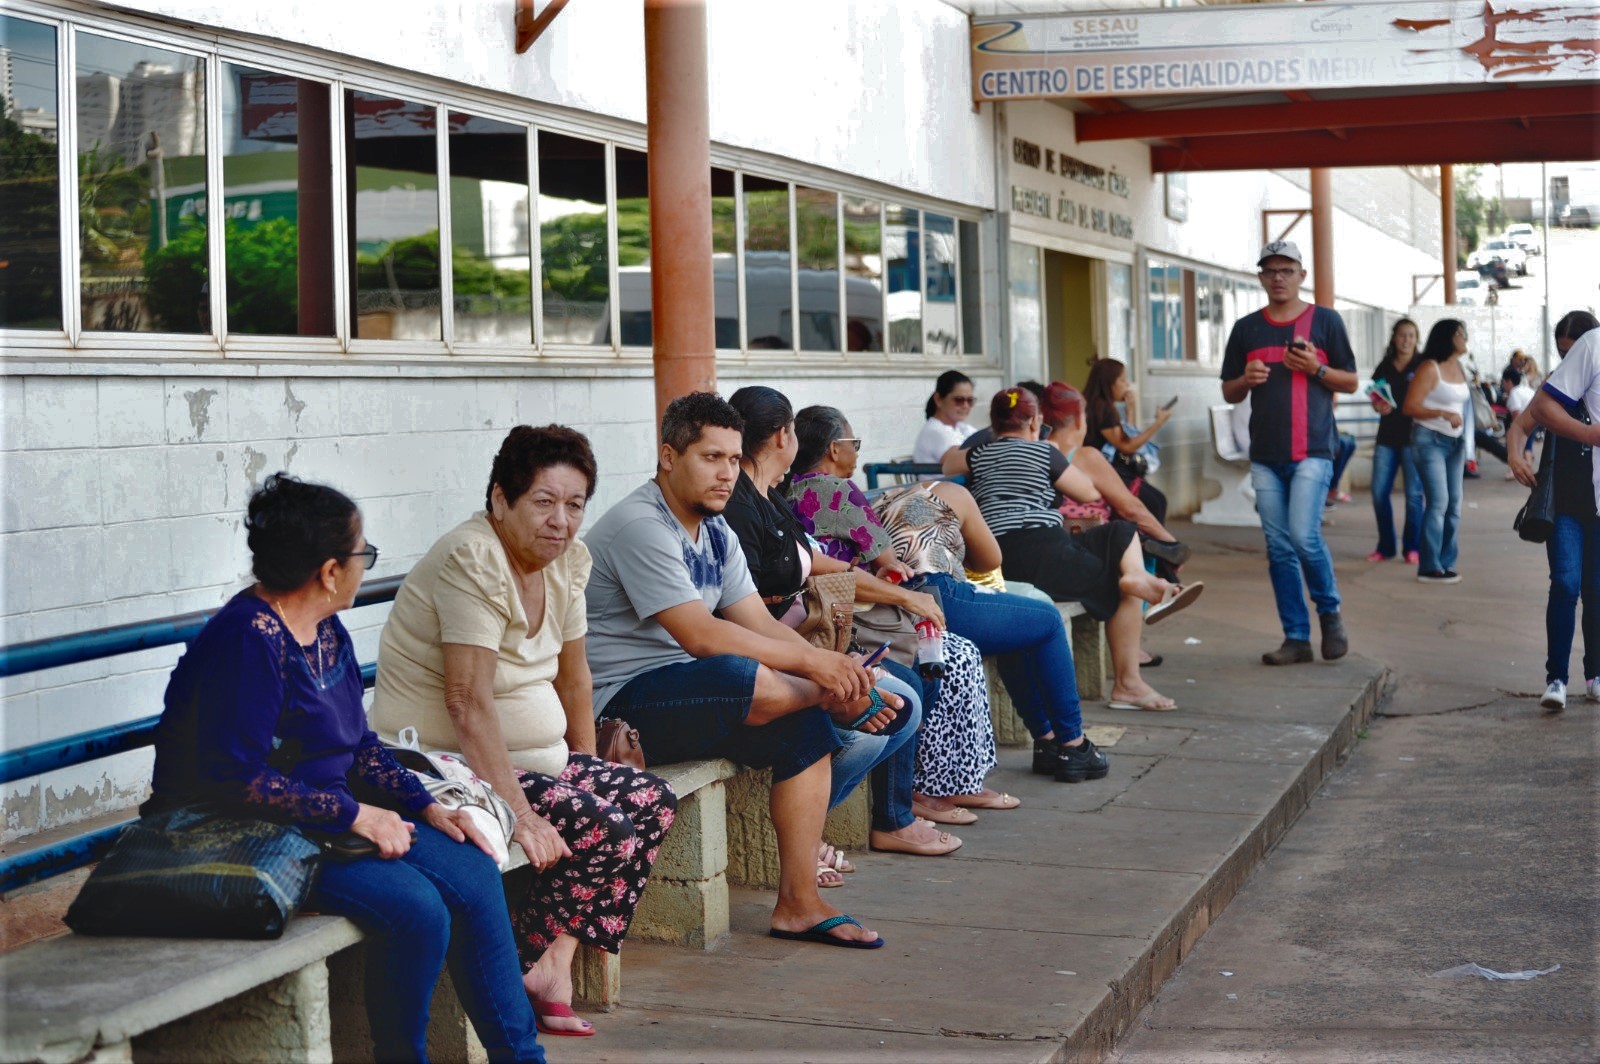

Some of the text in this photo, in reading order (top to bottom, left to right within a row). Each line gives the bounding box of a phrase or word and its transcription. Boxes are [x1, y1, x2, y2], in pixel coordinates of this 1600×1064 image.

[1073, 18, 1139, 34] SESAU
[982, 68, 1068, 97] CENTRO
[1077, 67, 1105, 92] DE
[1113, 58, 1301, 90] ESPECIALIDADES
